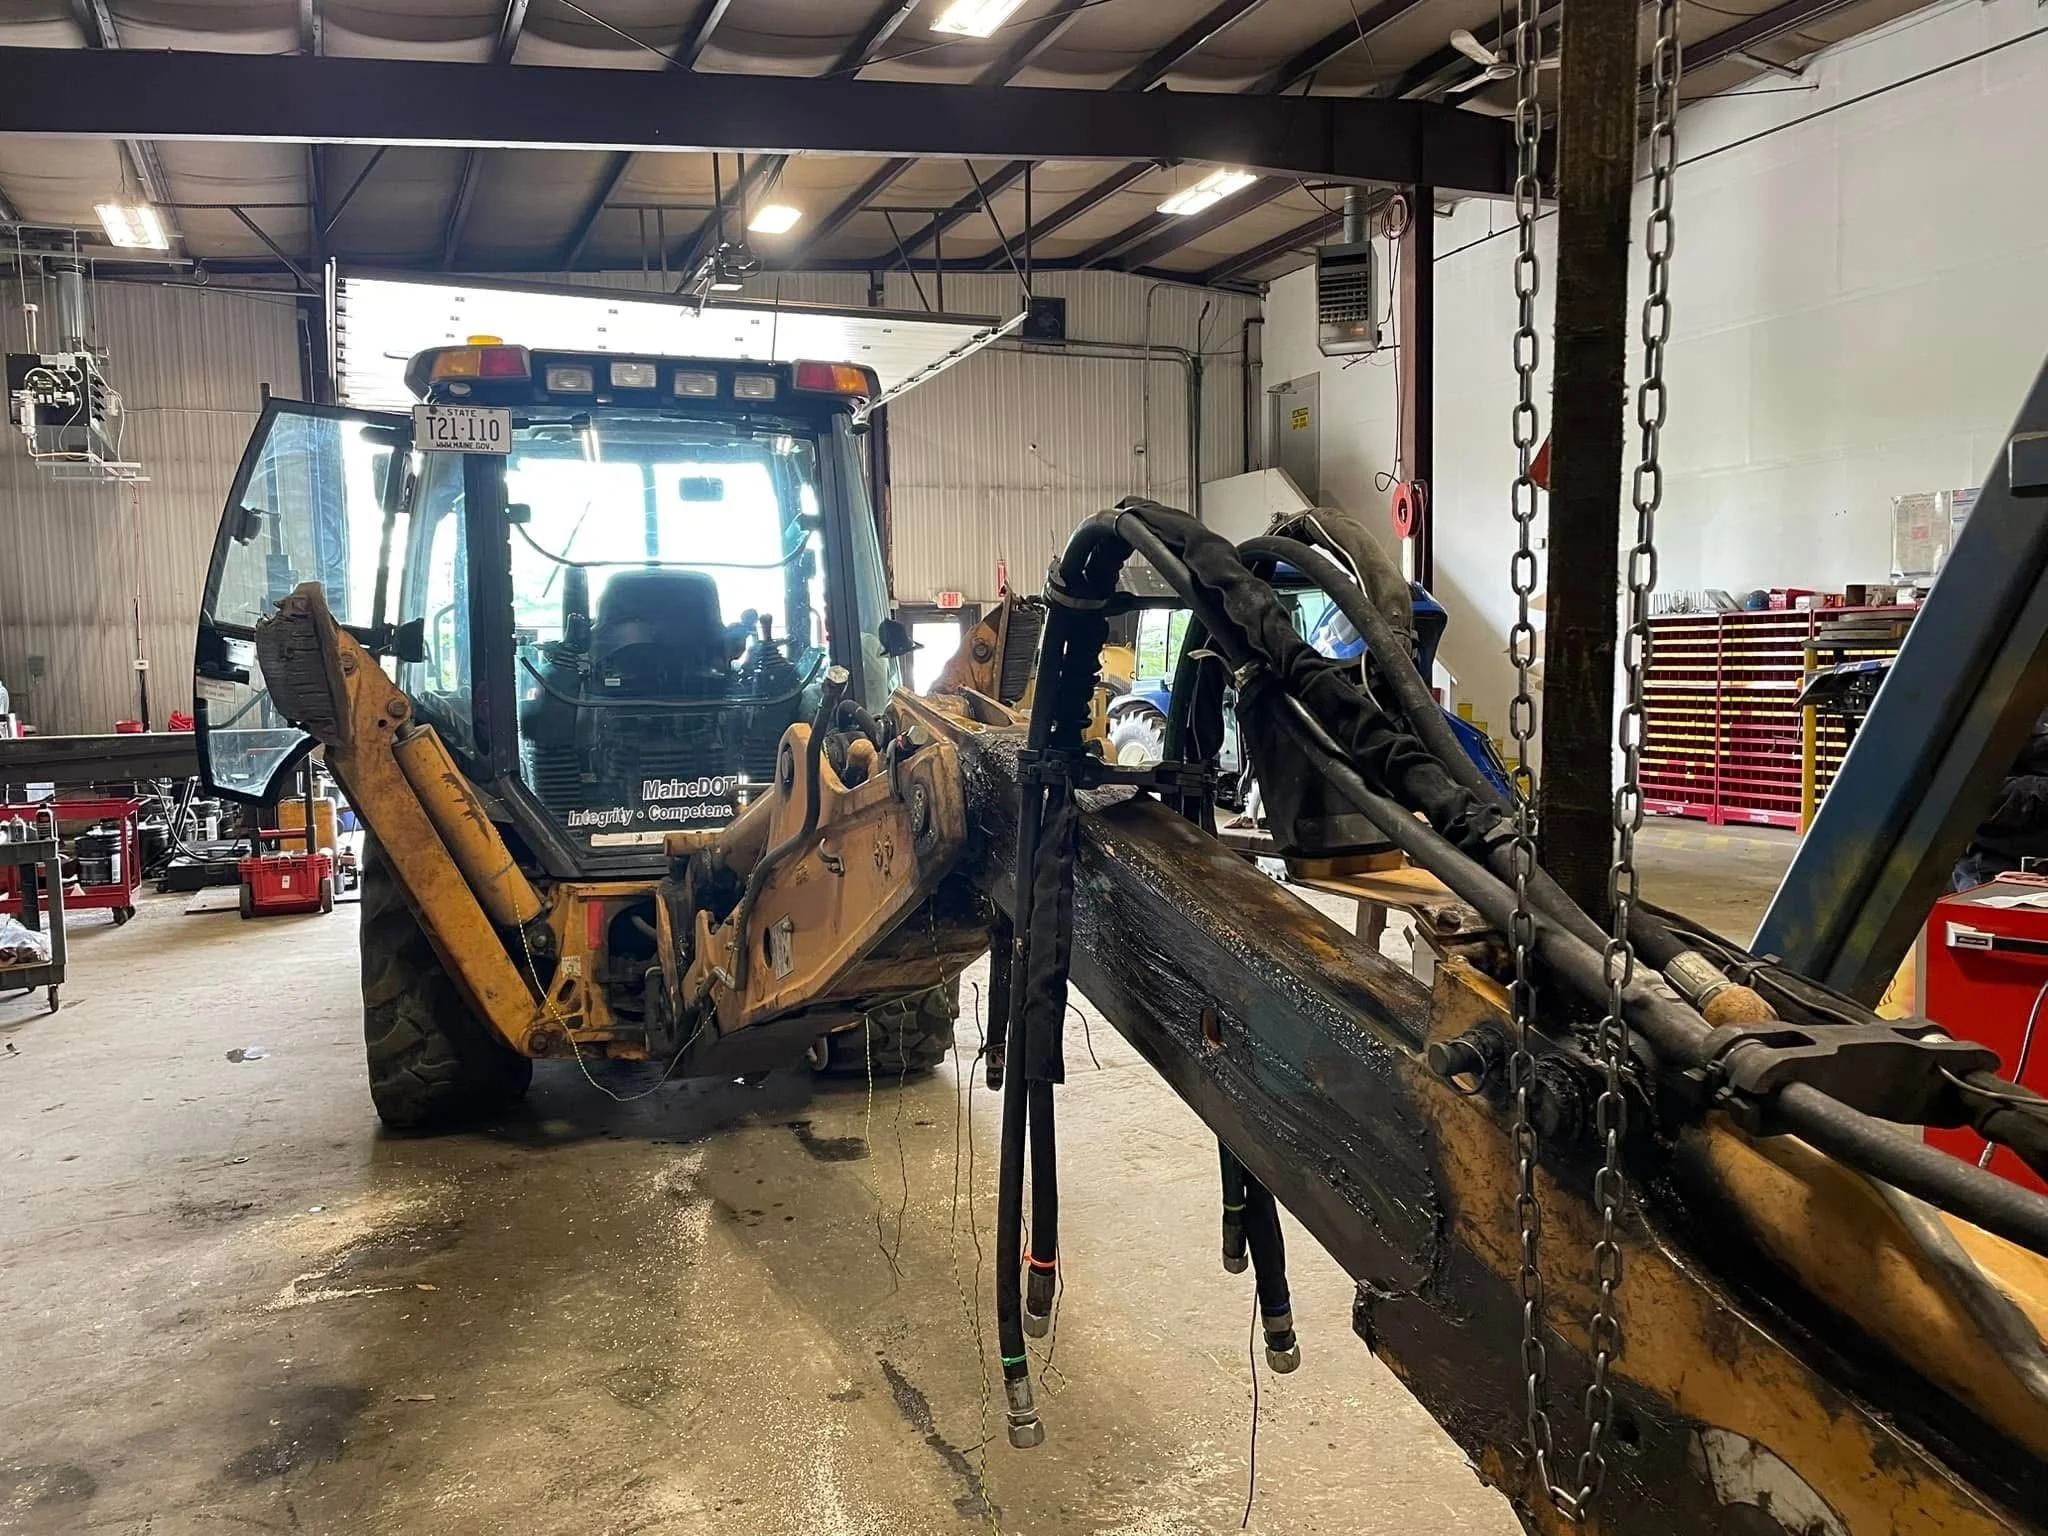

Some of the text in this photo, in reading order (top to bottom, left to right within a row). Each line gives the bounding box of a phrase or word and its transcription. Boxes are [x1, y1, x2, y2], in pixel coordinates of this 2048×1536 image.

[447, 408, 478, 417] STATE
[942, 593, 959, 606] EXIT
[642, 775, 738, 801] MaineDOT
[567, 802, 735, 828] Integrity Competenc
